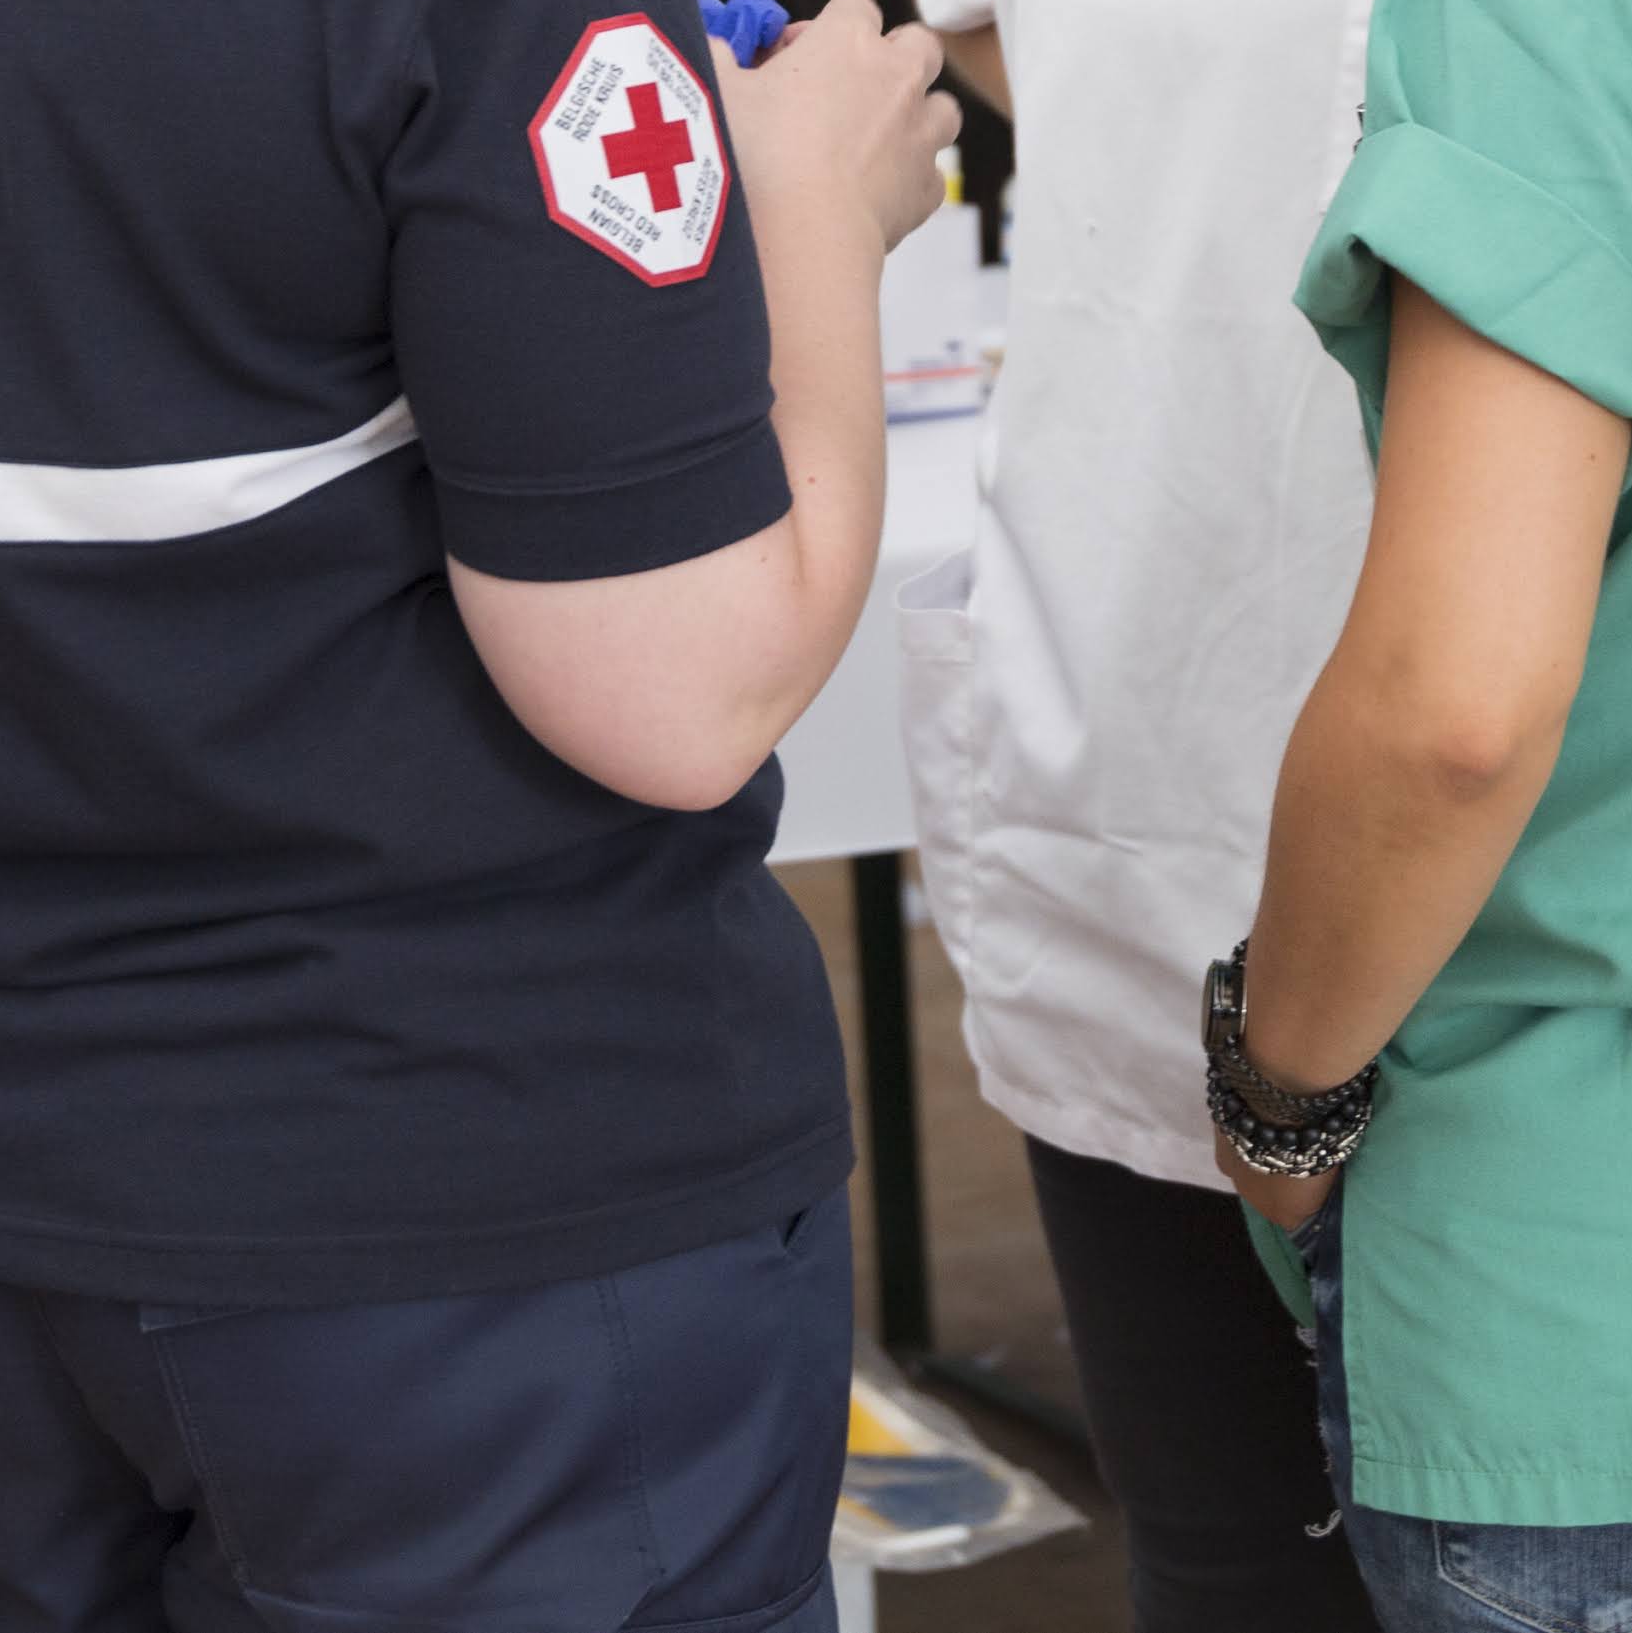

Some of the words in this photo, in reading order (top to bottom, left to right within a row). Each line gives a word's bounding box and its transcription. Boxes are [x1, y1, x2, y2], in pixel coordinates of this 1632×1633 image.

[555, 57, 607, 131] BELGISCHE
[573, 108, 602, 141] RODE
[596, 63, 624, 103] KRUIS
[589, 183, 631, 219] CROSS
[587, 207, 644, 253] BELGIAN
[634, 217, 662, 242] RED
